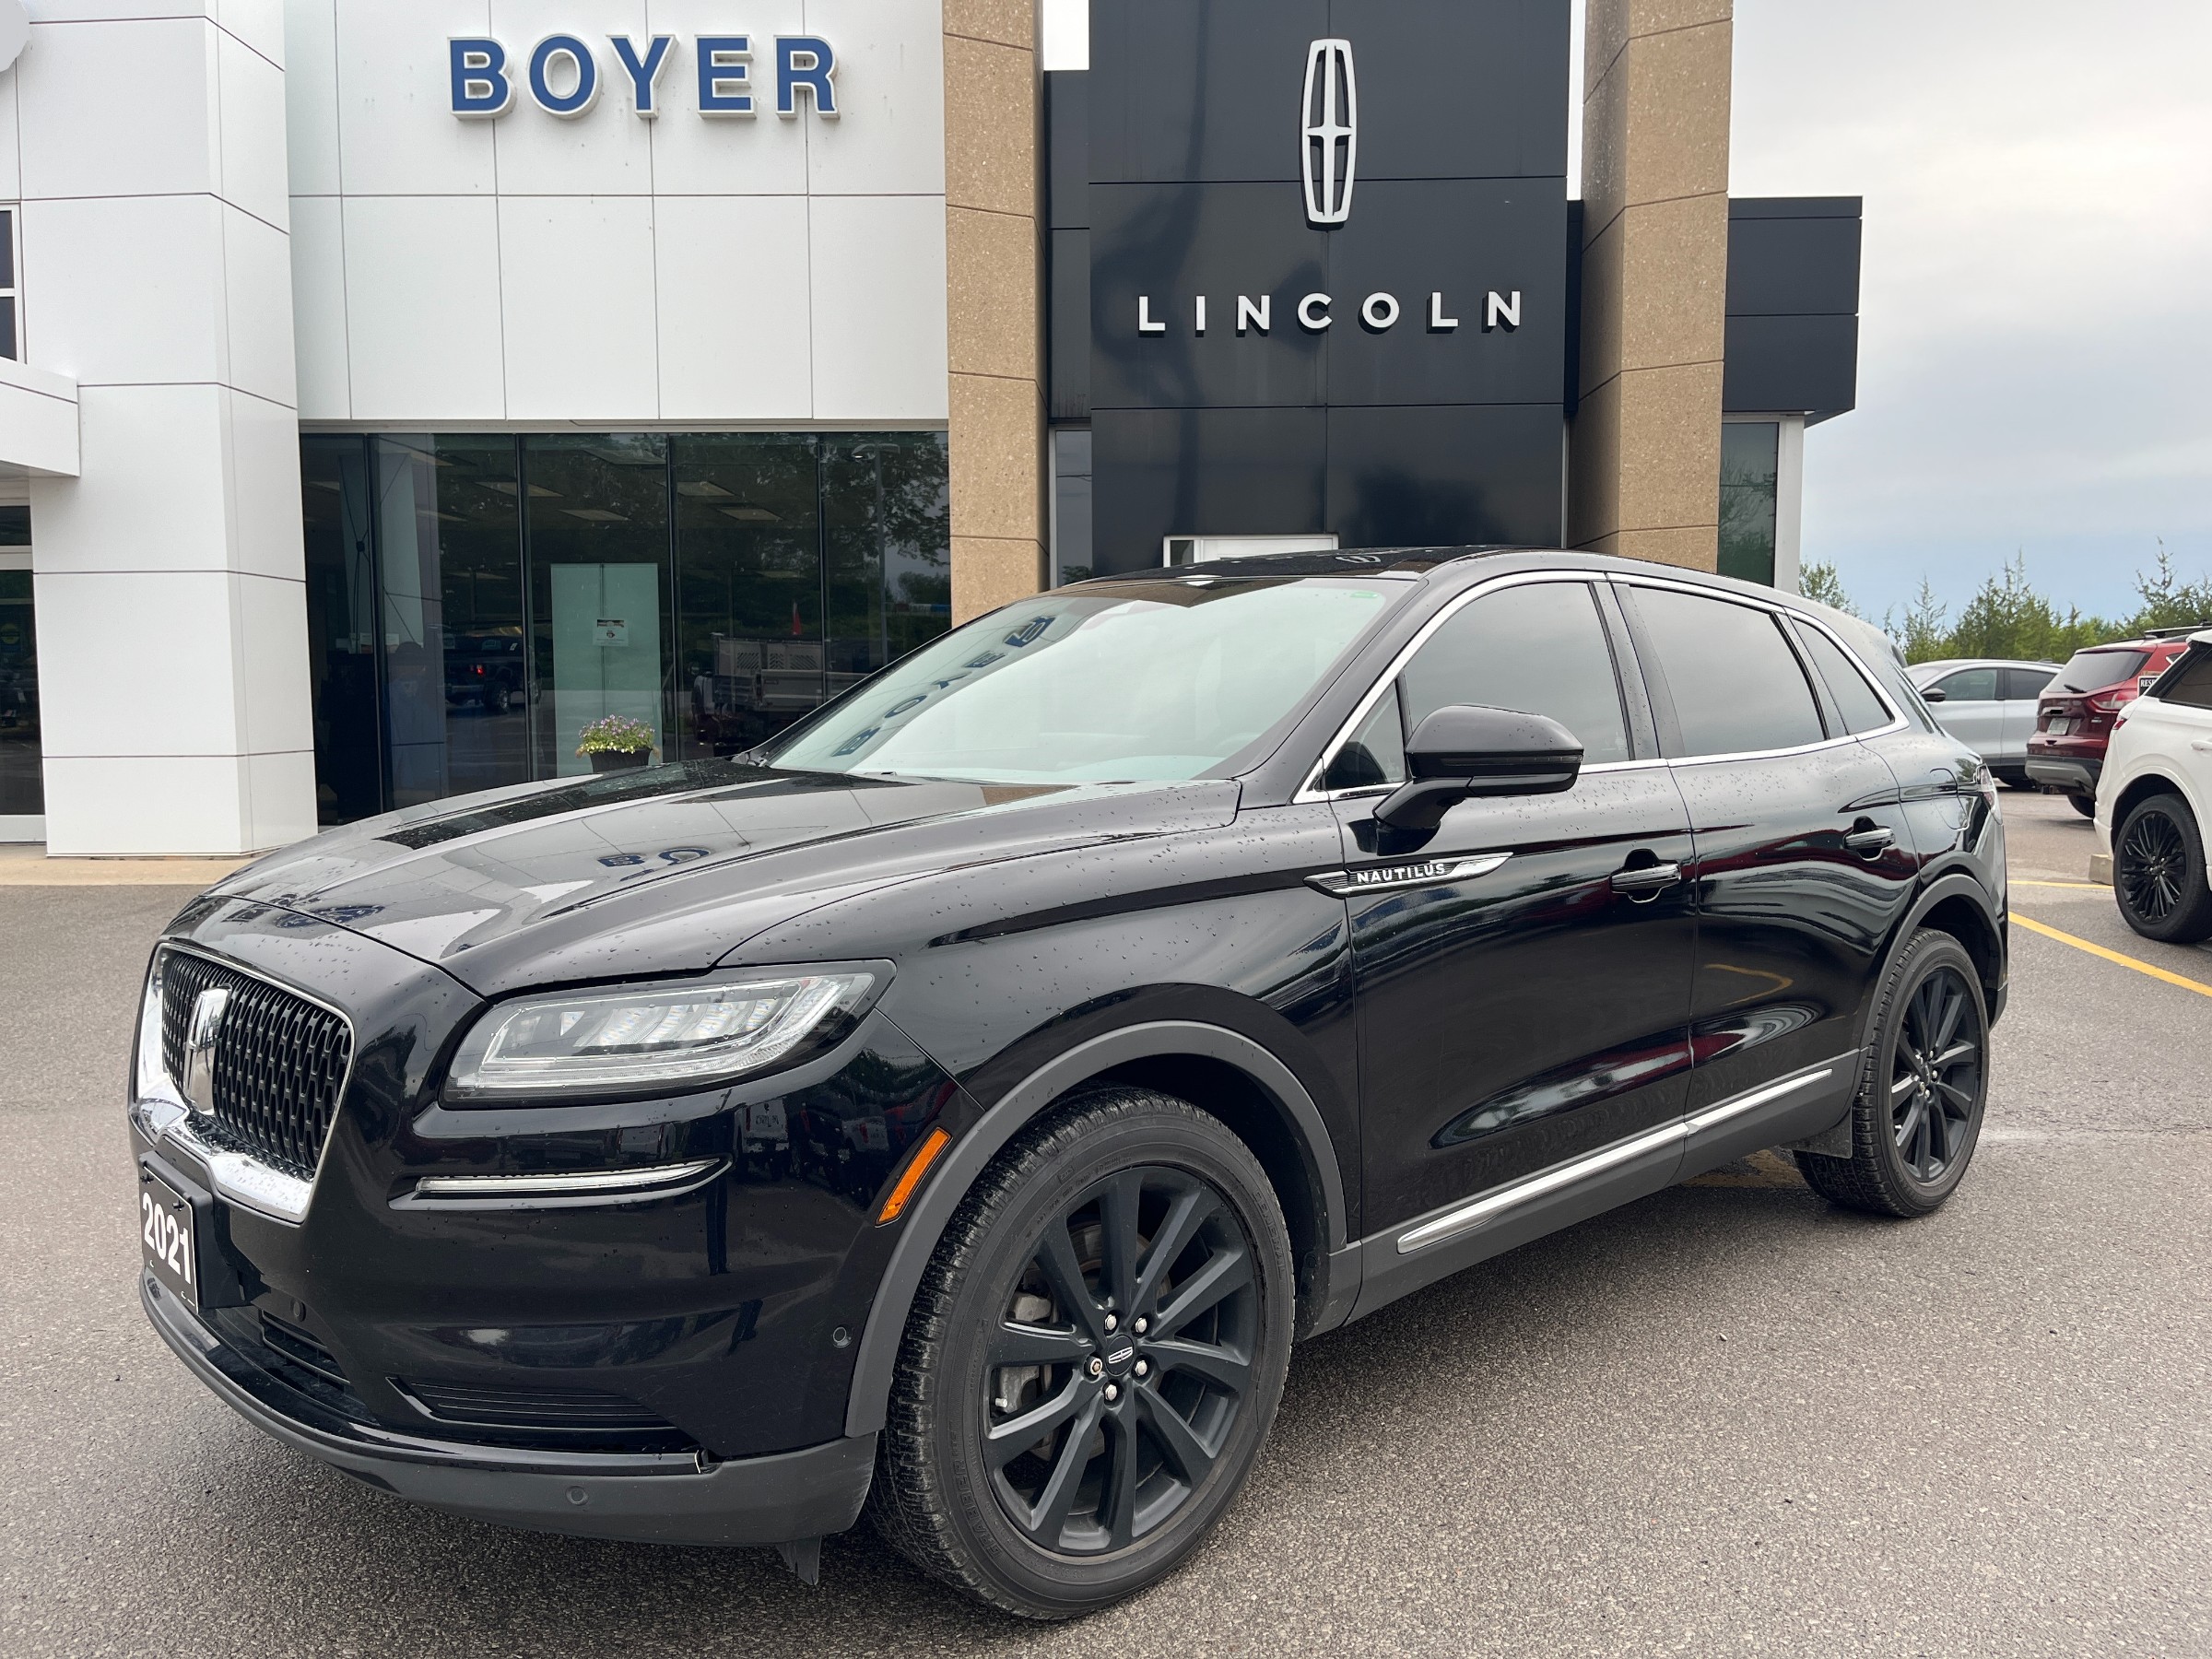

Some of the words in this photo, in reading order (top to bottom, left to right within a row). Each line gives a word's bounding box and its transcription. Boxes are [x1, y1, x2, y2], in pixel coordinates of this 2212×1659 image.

[447, 33, 840, 120] BOYER
[1137, 290, 1521, 334] LINCOLN
[1357, 863, 1446, 885] NAUTILUS
[142, 1192, 192, 1285] 2021
[953, 1459, 1001, 1558] GRABBER
